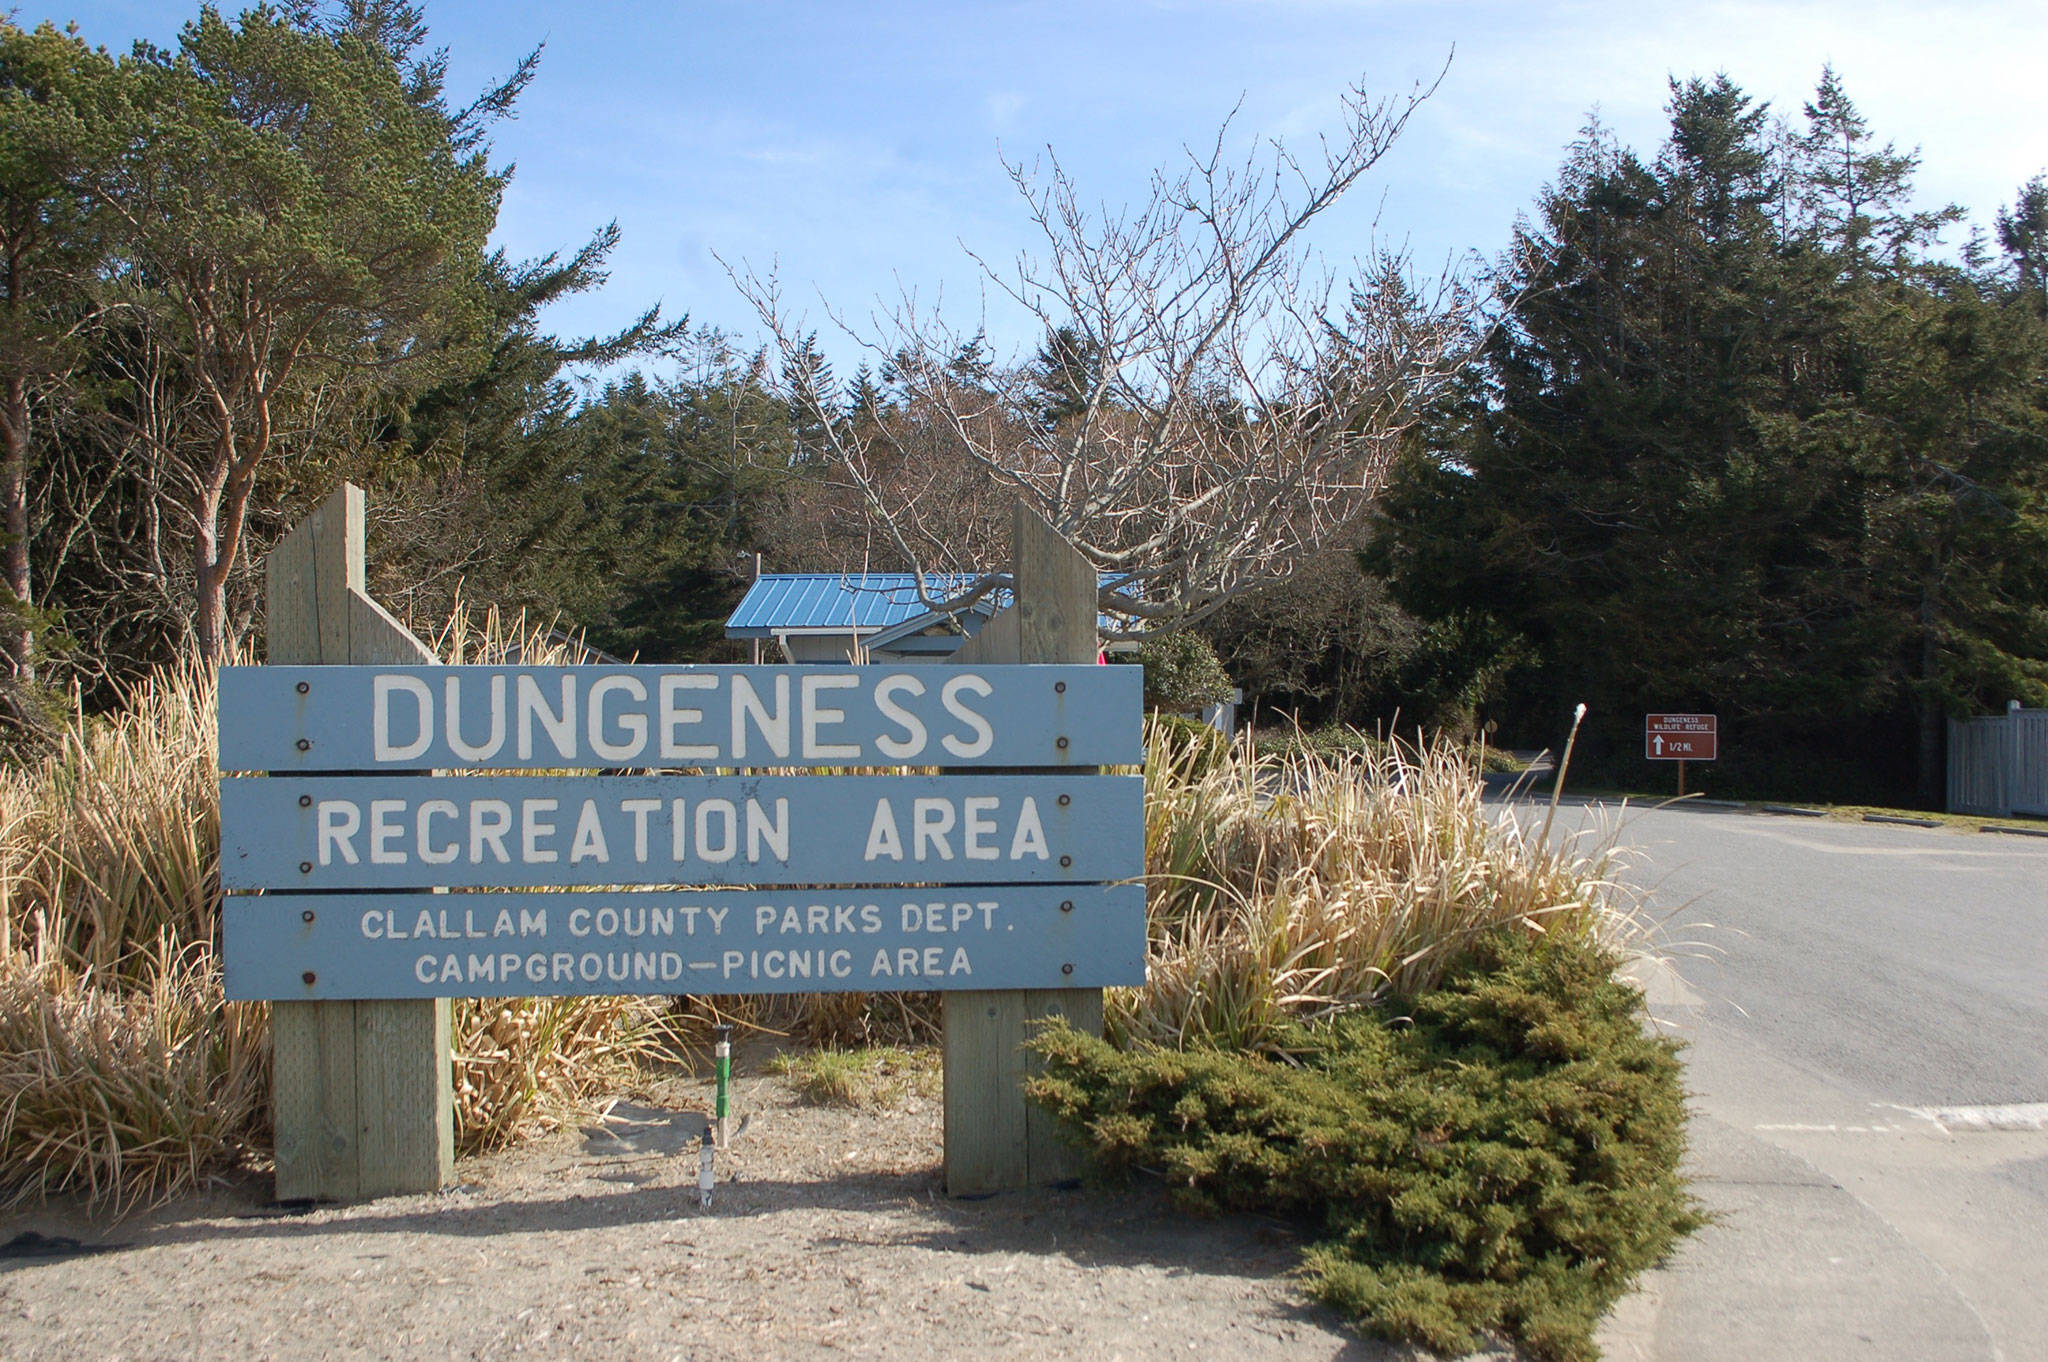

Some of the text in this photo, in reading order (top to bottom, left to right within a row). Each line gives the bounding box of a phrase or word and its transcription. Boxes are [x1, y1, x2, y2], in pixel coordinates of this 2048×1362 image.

[373, 674, 994, 762] DUNGENESS
[1669, 742, 1683, 752] 1/2
[317, 796, 1050, 866] RECREATION AREA
[361, 902, 1014, 939] CLALLAM COUNTY PARKS DEPT.
[871, 947, 972, 976] AREA
